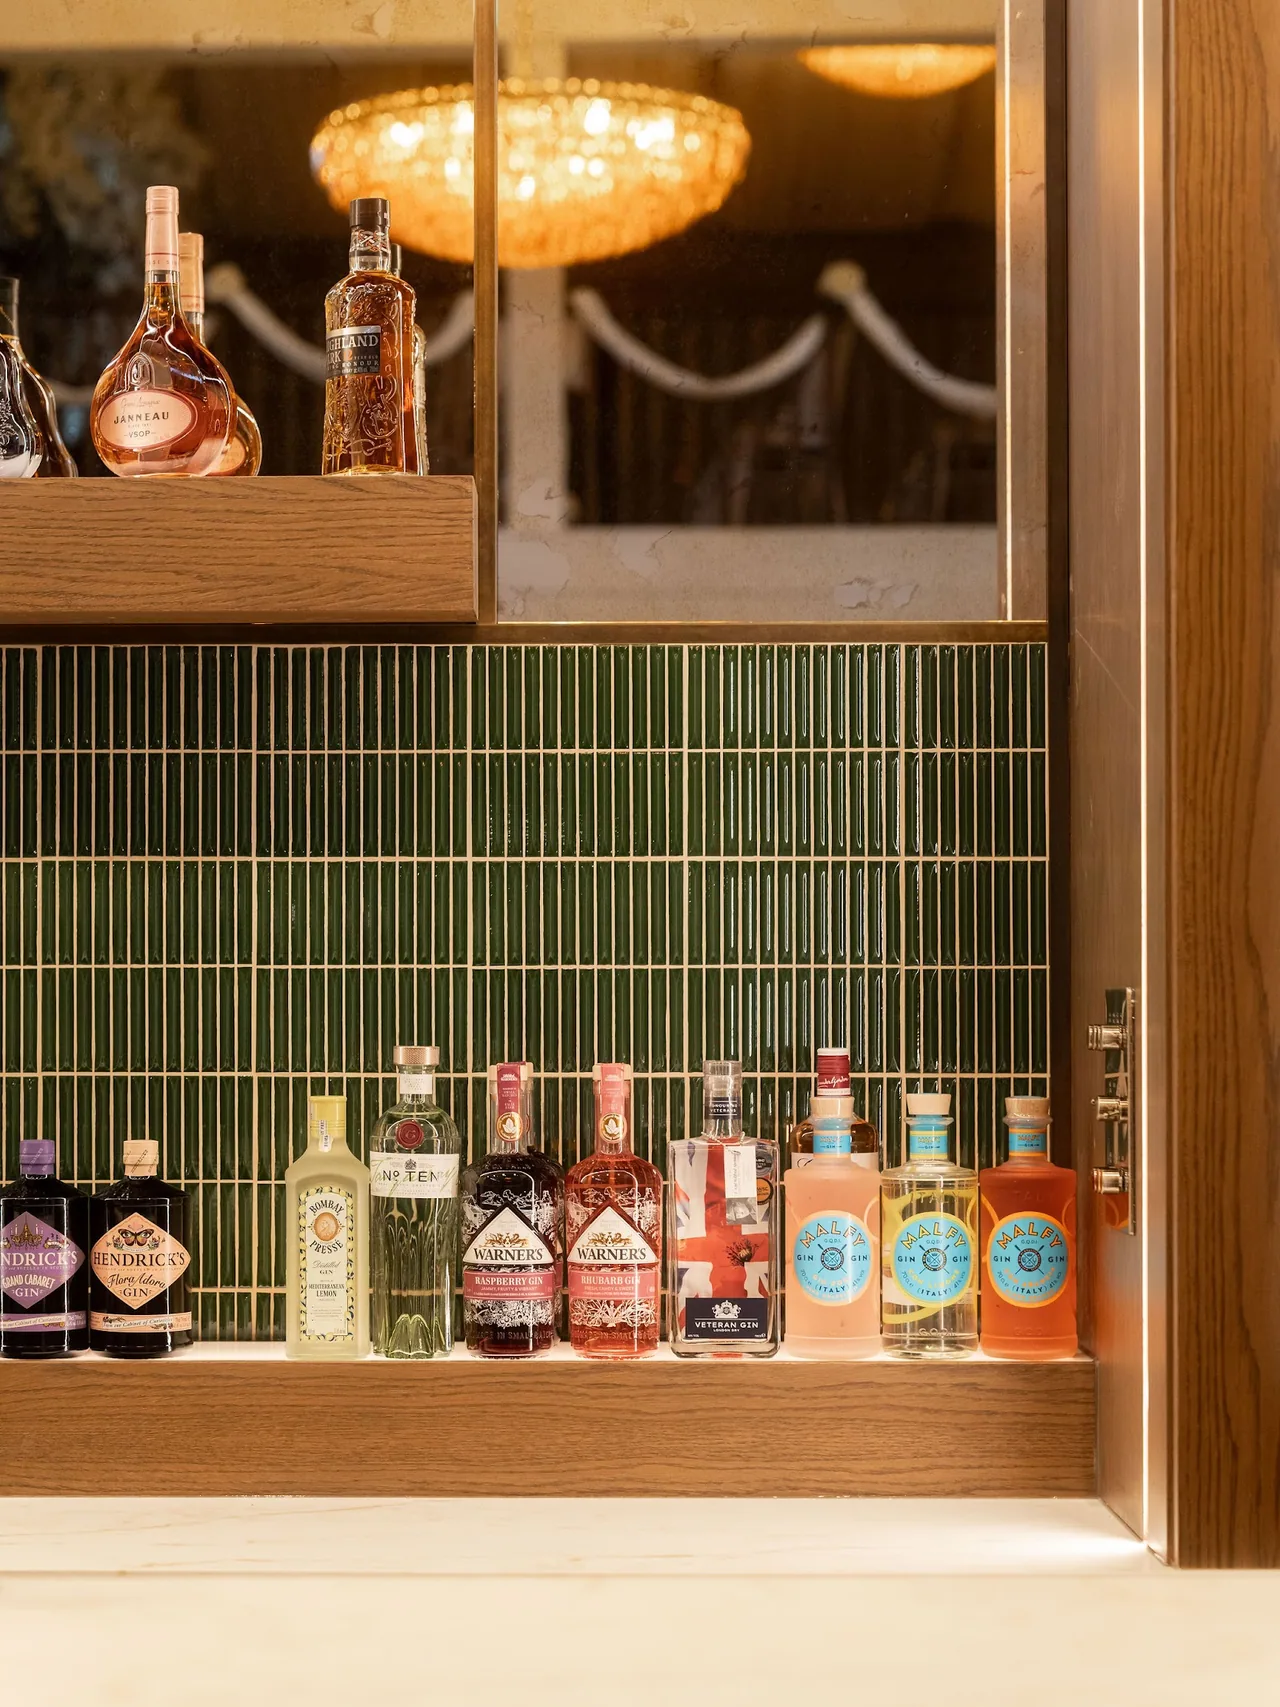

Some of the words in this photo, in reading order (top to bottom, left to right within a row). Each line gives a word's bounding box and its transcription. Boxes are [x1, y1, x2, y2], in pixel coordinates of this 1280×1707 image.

[114, 412, 170, 425] JANNEAU
[128, 430, 151, 438] VSOP
[405, 1171, 439, 1182] TEN
[309, 1200, 344, 1214] BOMBAY
[800, 1221, 865, 1248] MALFY
[901, 1222, 966, 1250] MALFY
[997, 1222, 1063, 1250] MALFY
[0, 1250, 78, 1266] NDRICK'S
[93, 1252, 185, 1267] HENDRICK'S
[473, 1248, 543, 1261] WARNER'S
[577, 1247, 647, 1260] WARNER'S
[312, 1260, 341, 1269] Distilled
[3, 1275, 24, 1289] GRAND
[24, 1274, 56, 1289] CABARET
[107, 1273, 135, 1288] Flora
[130, 1272, 166, 1288] Adora
[475, 1276, 527, 1285] RASPBERRY
[528, 1276, 543, 1285] GIN
[581, 1276, 623, 1284] RHUBARB
[625, 1276, 641, 1284] GIN
[15, 1288, 39, 1297] GIN
[123, 1288, 149, 1297] GIN
[916, 1286, 952, 1296] (ITALY)
[1011, 1284, 1047, 1294] (ITALY)
